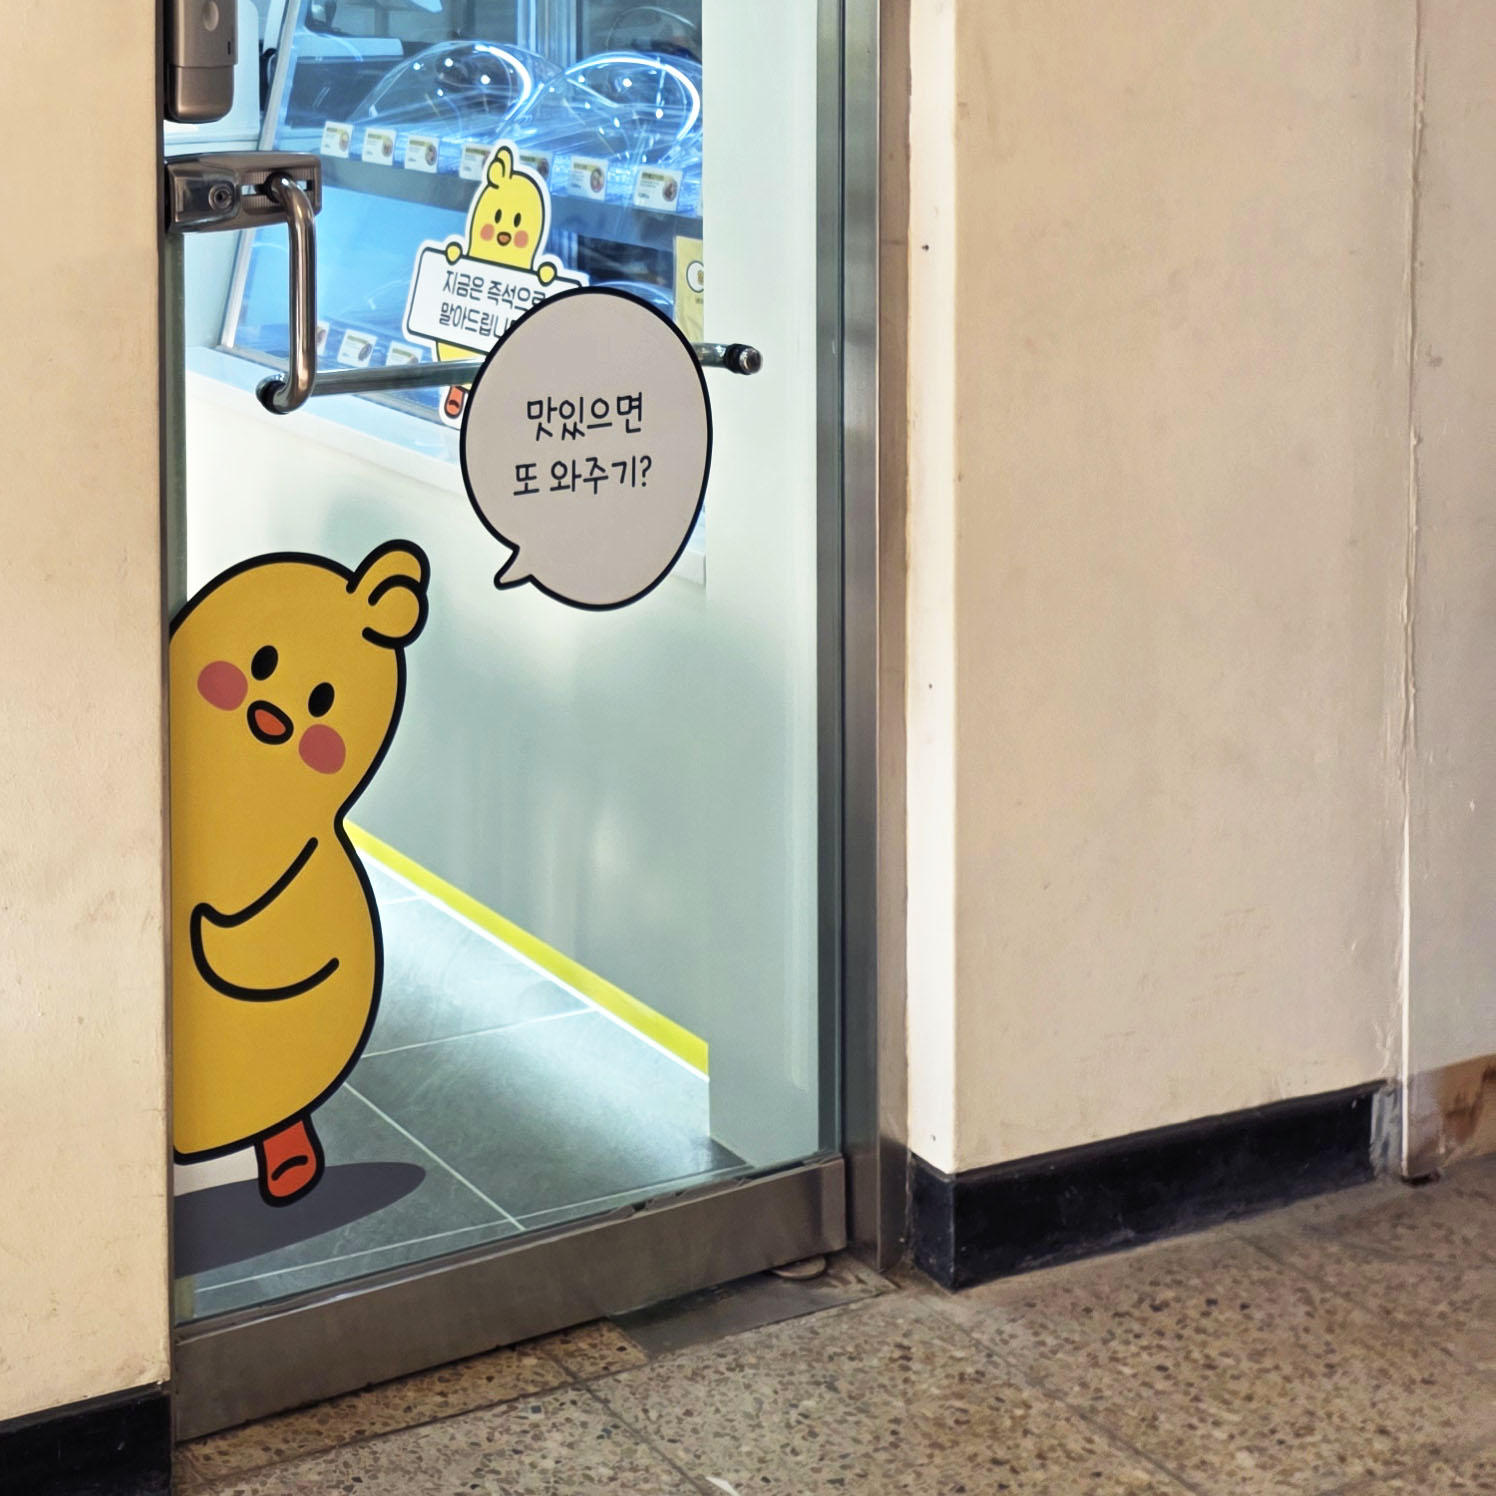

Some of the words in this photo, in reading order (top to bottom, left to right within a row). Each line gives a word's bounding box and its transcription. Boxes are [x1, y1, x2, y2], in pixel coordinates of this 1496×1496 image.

[442, 270, 485, 301] 지금은
[439, 302, 516, 338] 말아드립니
[526, 391, 644, 442] 맛있으면
[513, 463, 541, 497] 또
[549, 455, 653, 496] 와주기?
